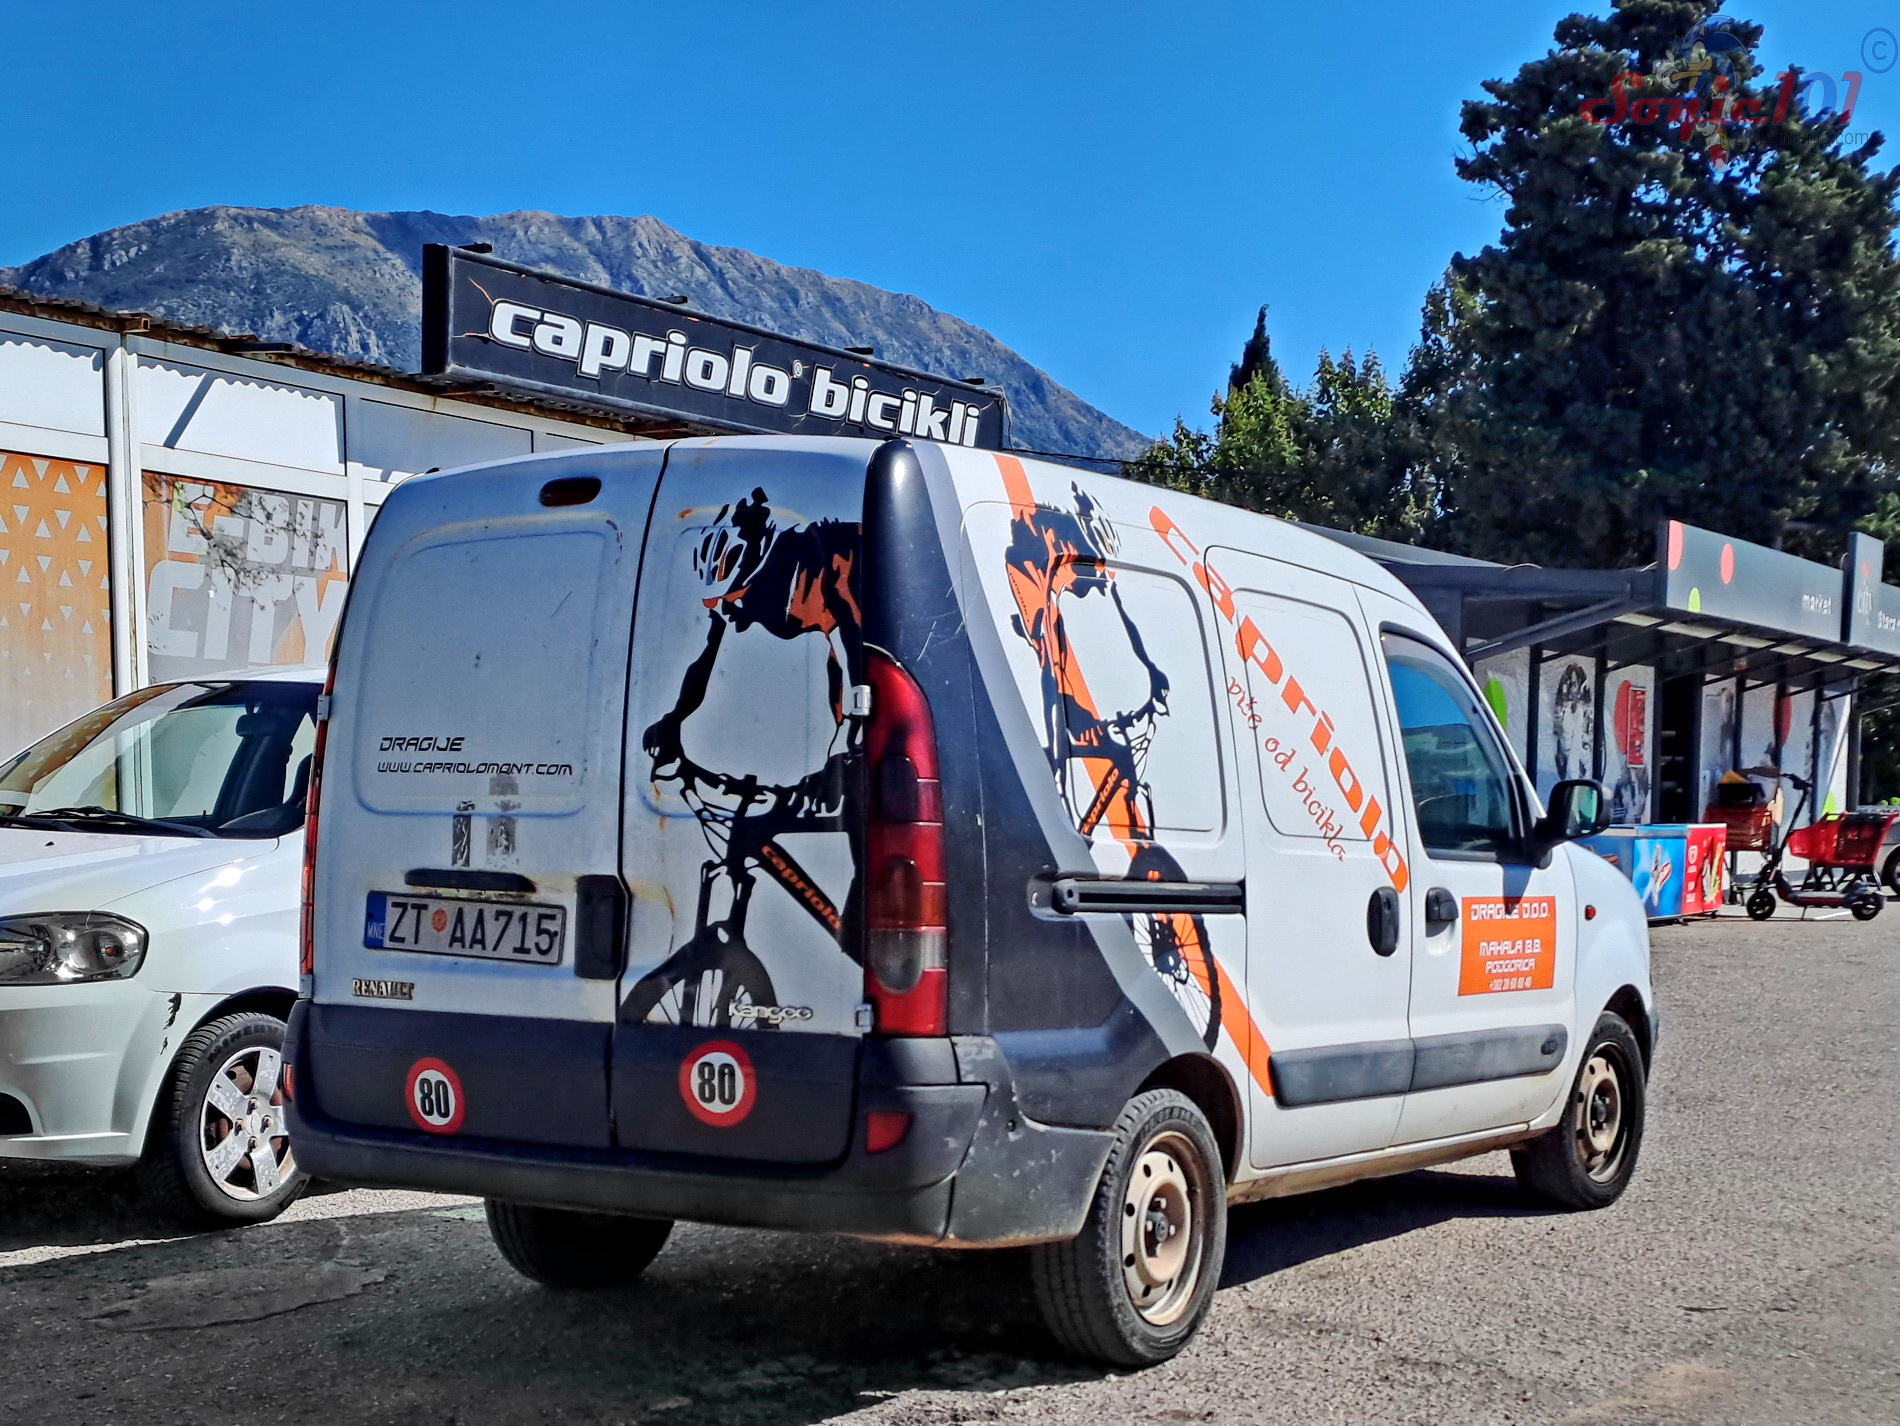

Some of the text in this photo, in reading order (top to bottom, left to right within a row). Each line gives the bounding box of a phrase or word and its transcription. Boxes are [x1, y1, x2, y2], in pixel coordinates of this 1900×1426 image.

[809, 364, 981, 448] bicikli
[147, 559, 349, 665] CITY
[1148, 506, 1408, 894] capriolo
[379, 736, 466, 752] DRAGIJE
[1264, 737, 1297, 773] od
[1291, 766, 1348, 862] bicikla
[367, 922, 386, 940] MNE
[388, 901, 559, 956] ZT AA715
[352, 978, 414, 1000] RENAULT
[729, 1000, 813, 1024] Kangoo
[418, 1077, 451, 1119] 80
[697, 1061, 737, 1105] 80
